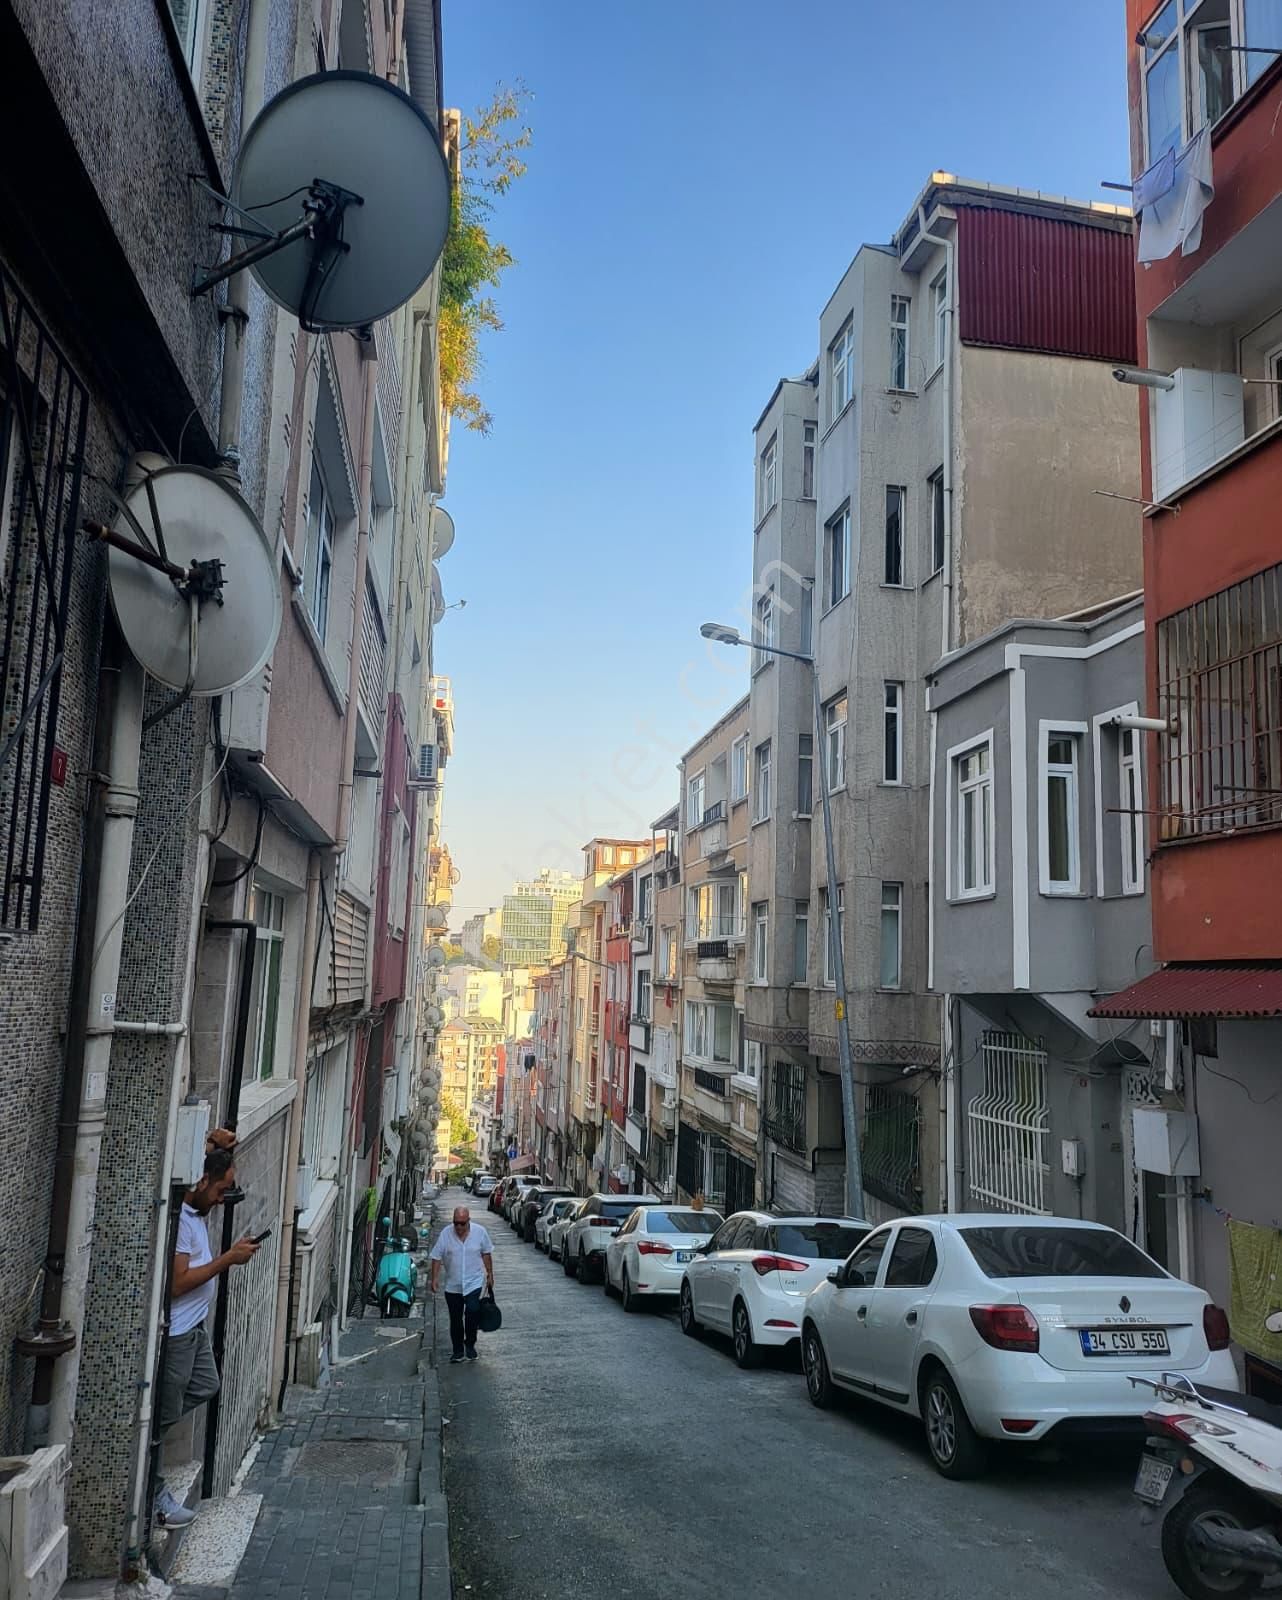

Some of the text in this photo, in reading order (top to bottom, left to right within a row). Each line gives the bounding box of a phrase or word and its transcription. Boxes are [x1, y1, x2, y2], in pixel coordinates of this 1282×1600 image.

[1089, 1332, 1166, 1350] 34 CSU 550
